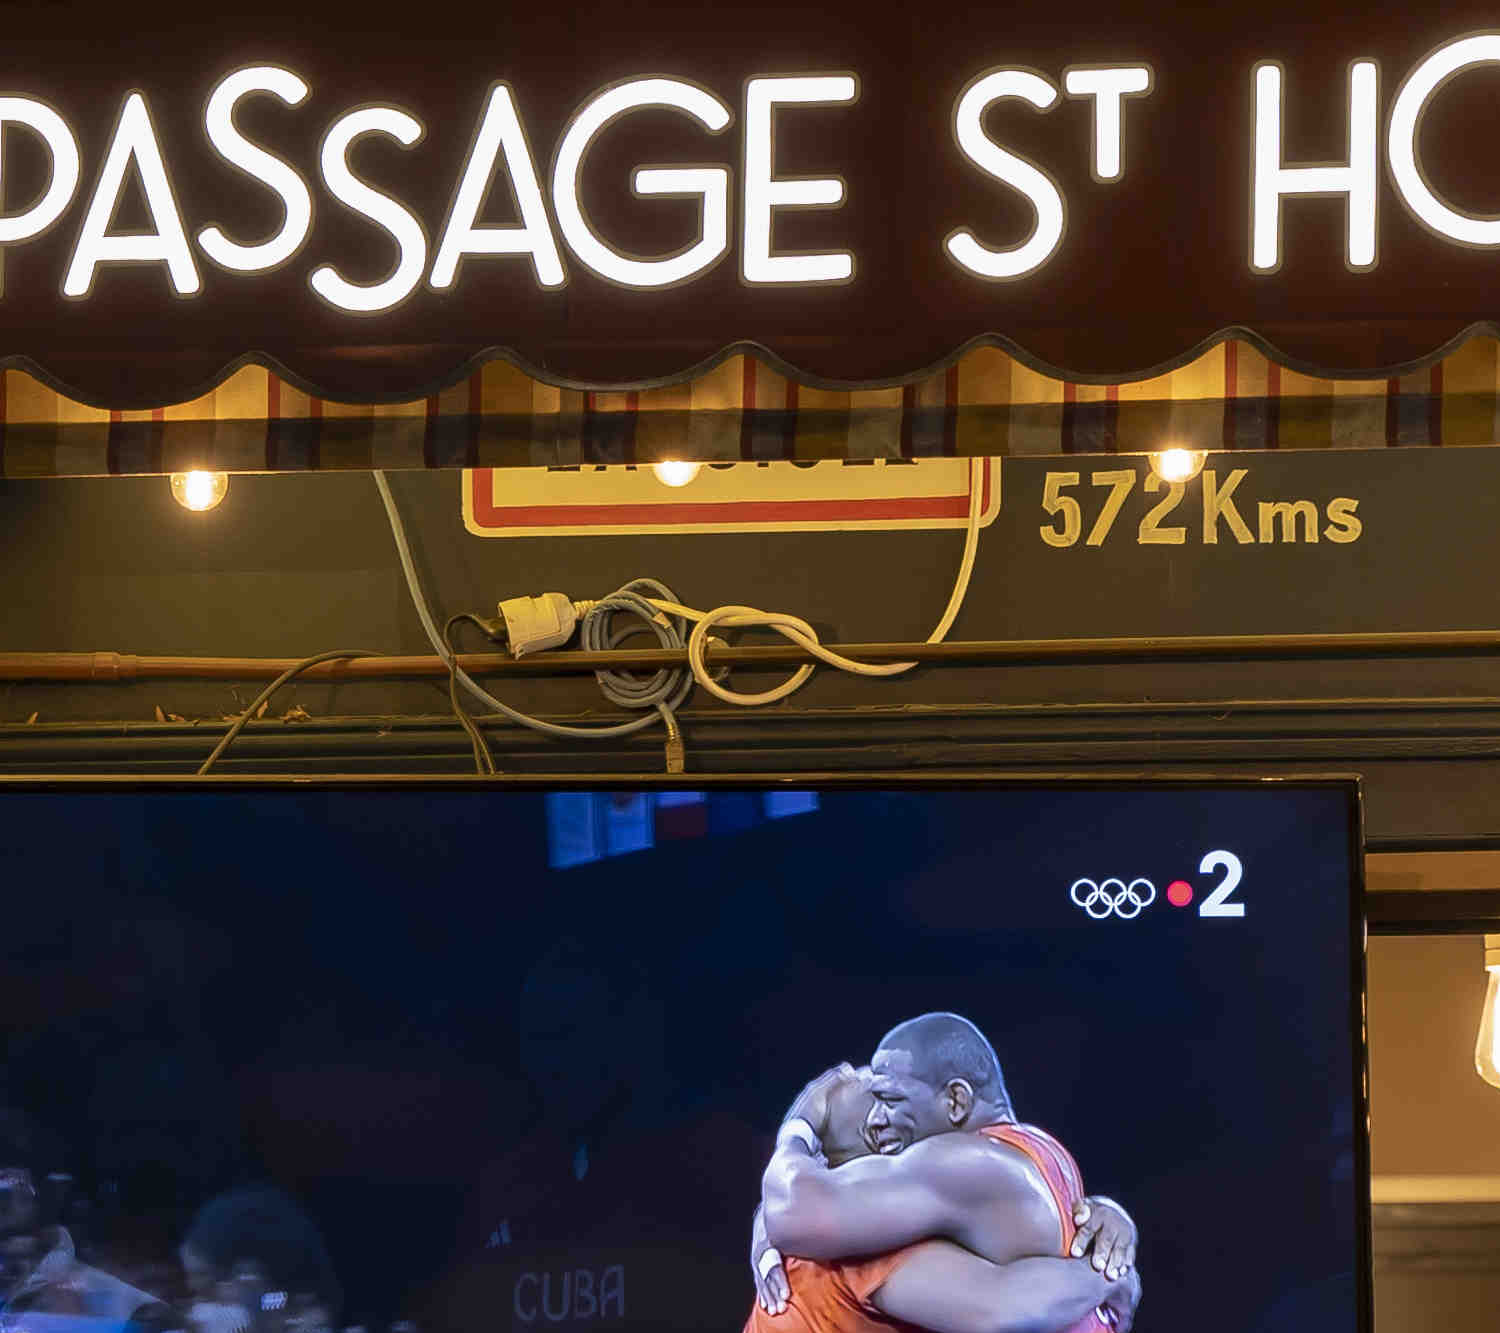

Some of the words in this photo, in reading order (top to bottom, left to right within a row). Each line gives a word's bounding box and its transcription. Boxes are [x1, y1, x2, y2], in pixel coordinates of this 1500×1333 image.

[943, 62, 1151, 280] ST
[1038, 466, 1362, 548] 572Kms
[1198, 848, 1247, 918] 2
[513, 1263, 626, 1323] CUBA
